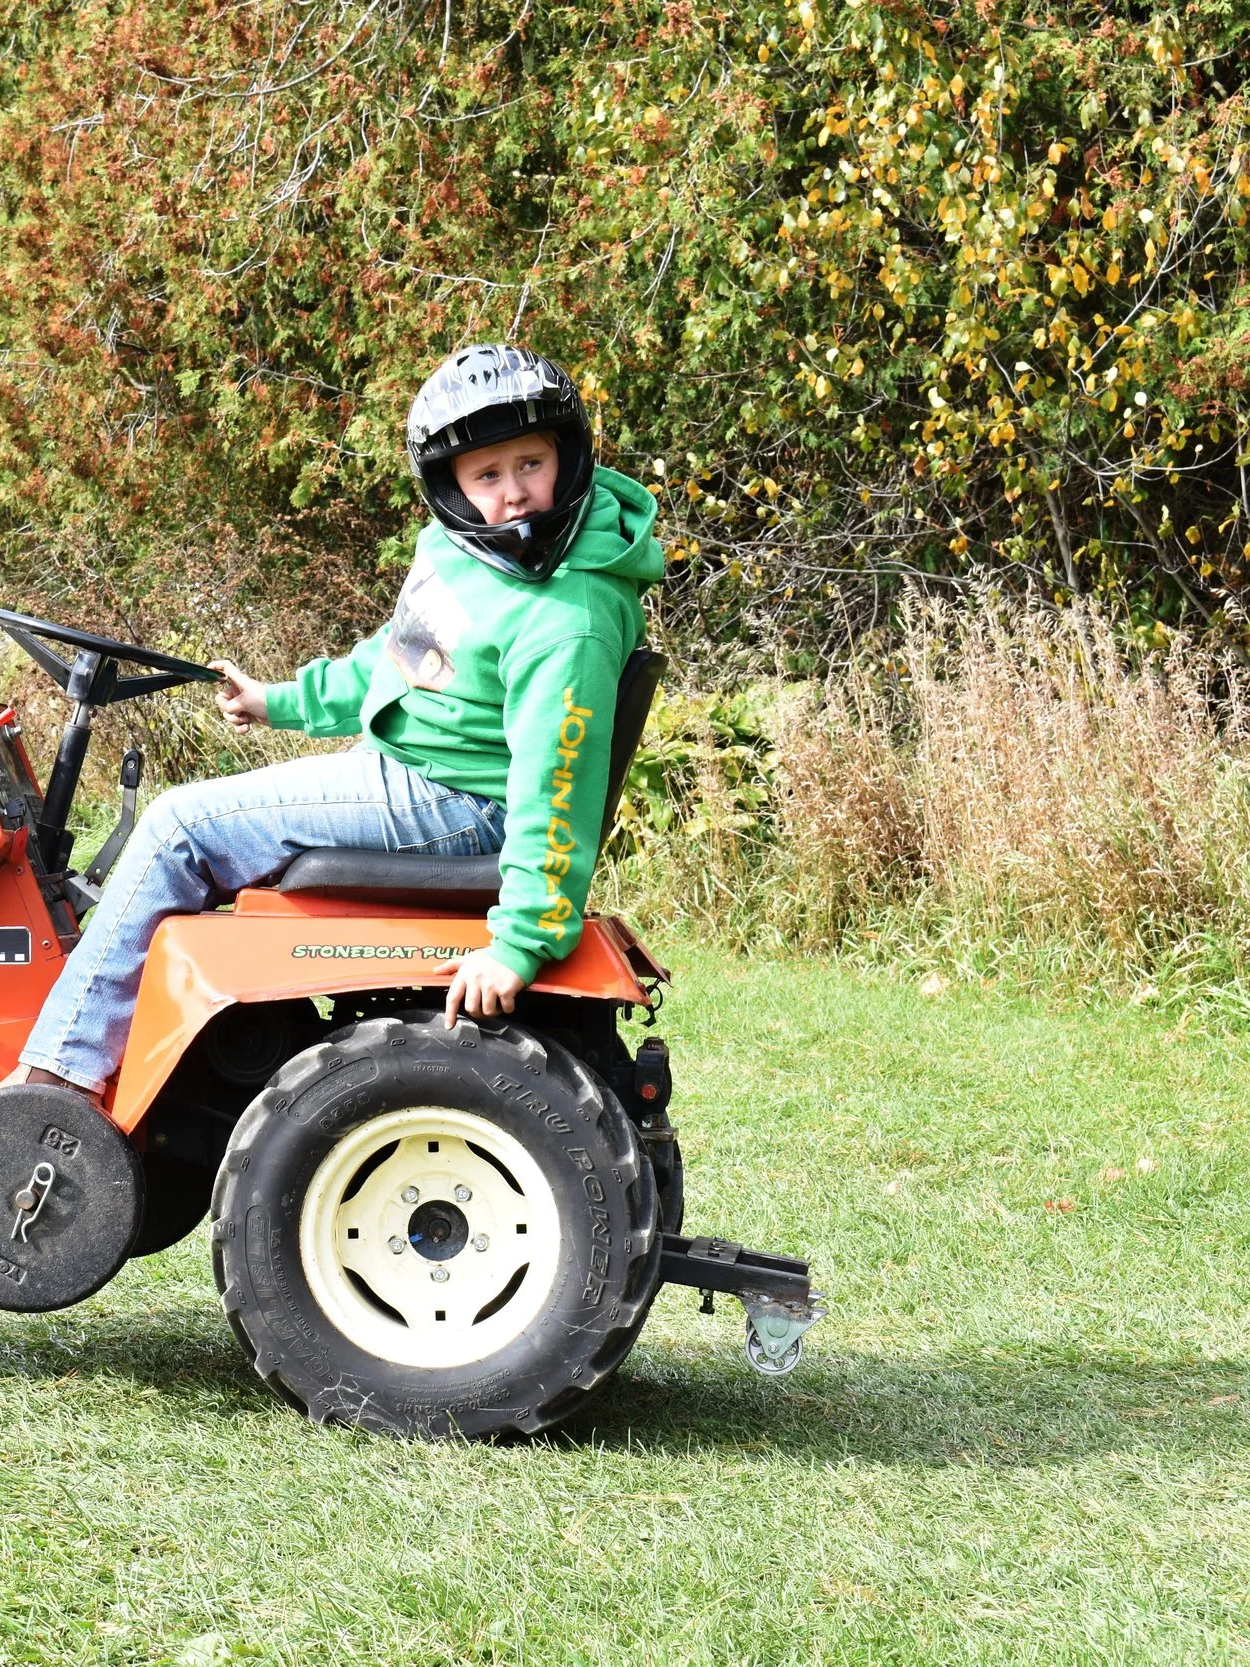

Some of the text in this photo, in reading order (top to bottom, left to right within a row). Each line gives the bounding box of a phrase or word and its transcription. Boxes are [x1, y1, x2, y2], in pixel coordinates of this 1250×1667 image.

[551, 687, 594, 811] JOHN
[291, 945, 418, 959] STONEBOAT
[493, 1073, 611, 1306] TRU POWER
